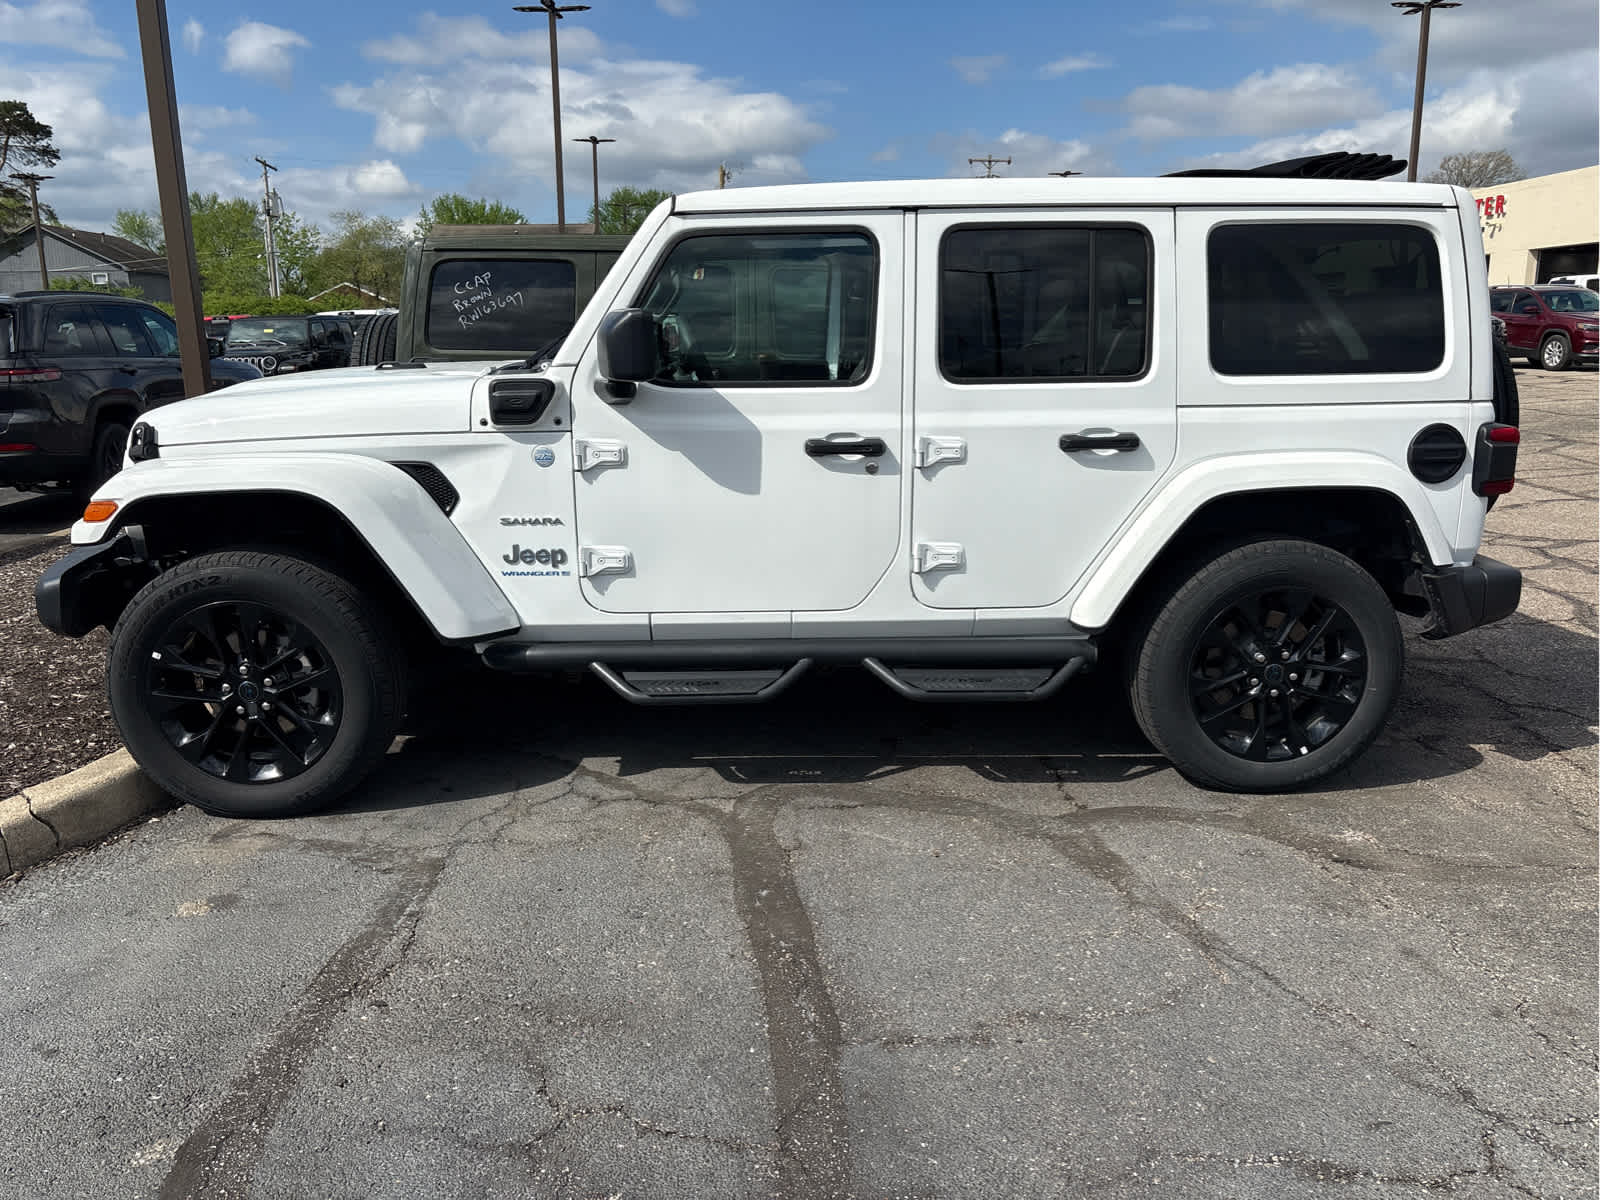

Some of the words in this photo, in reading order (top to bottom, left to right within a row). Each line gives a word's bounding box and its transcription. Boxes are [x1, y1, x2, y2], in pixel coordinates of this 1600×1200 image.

[454, 271, 491, 294] CCAP
[500, 518, 565, 526] SAHARA
[502, 544, 568, 569] Jeep
